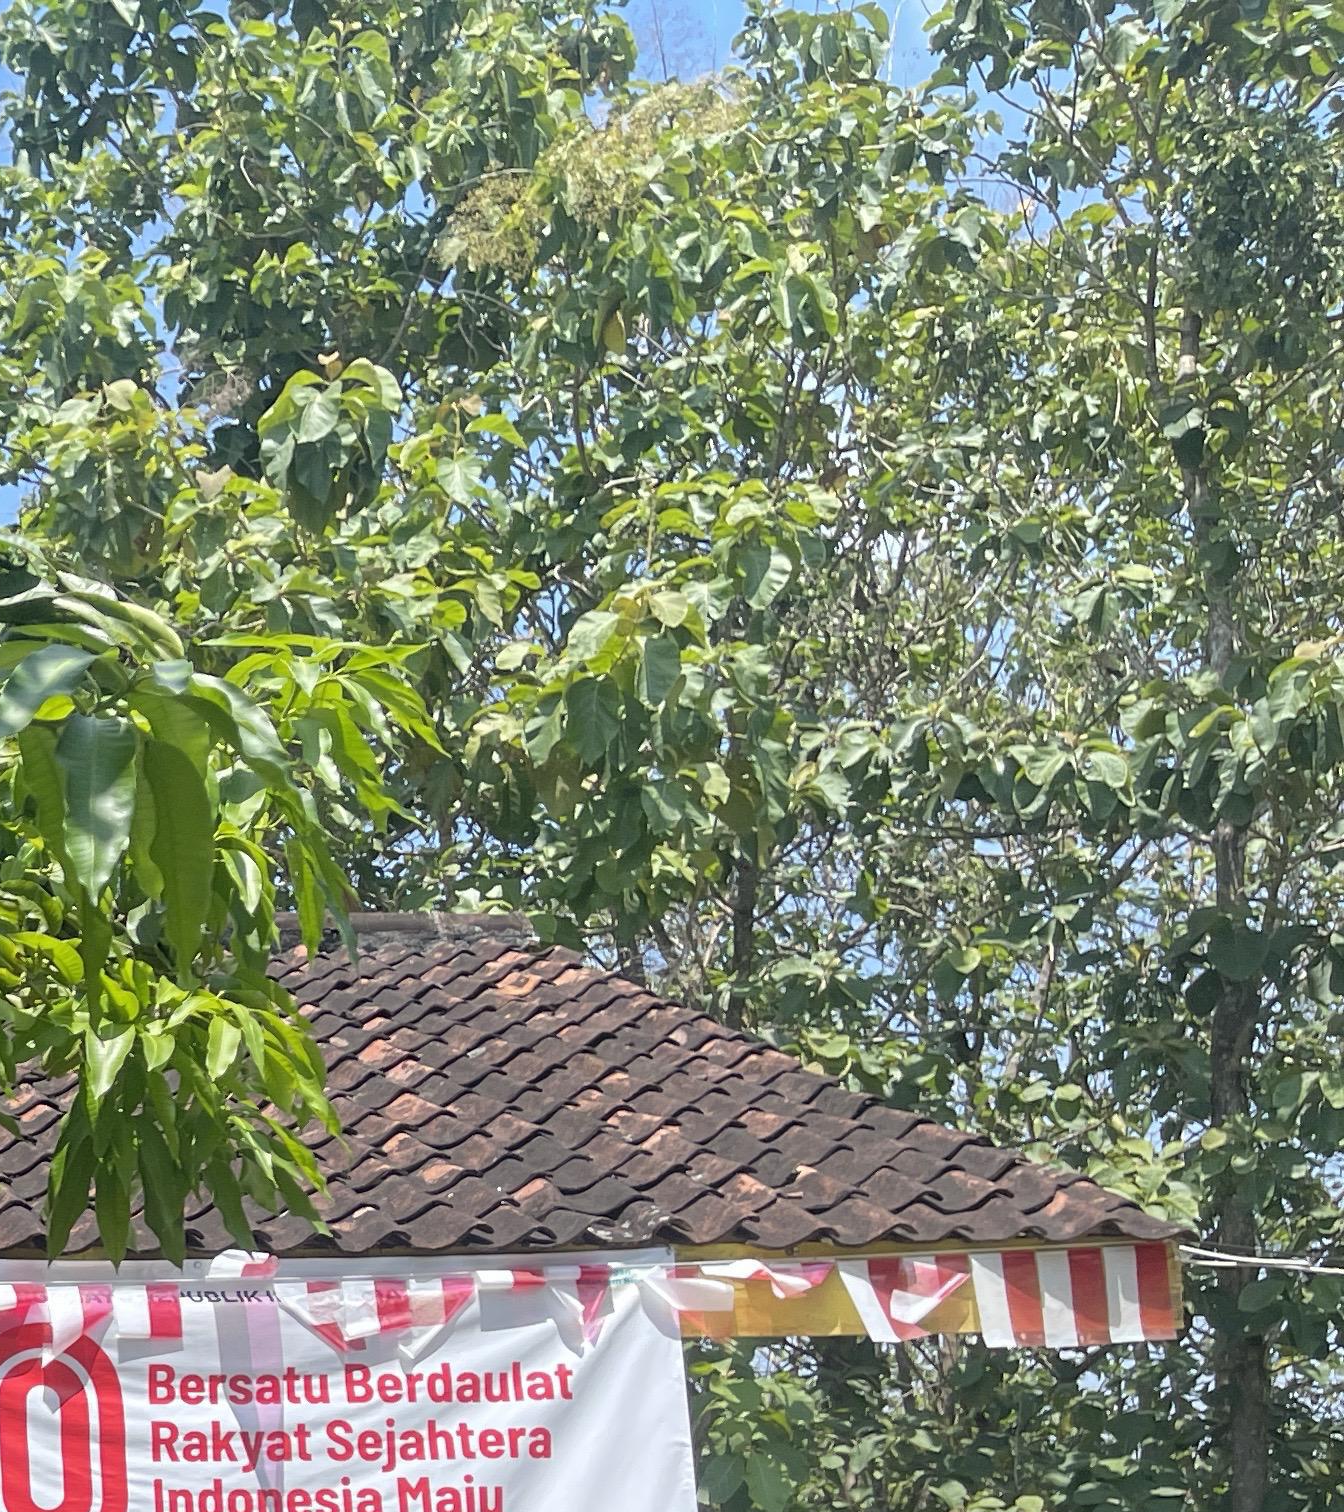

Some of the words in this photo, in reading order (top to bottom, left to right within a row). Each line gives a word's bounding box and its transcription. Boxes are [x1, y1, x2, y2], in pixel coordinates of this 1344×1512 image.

[148, 1363, 330, 1406] Bersatu
[344, 1361, 574, 1405] Berdaulat
[150, 1420, 312, 1474] Rakyat
[326, 1418, 553, 1473] Sejahtera
